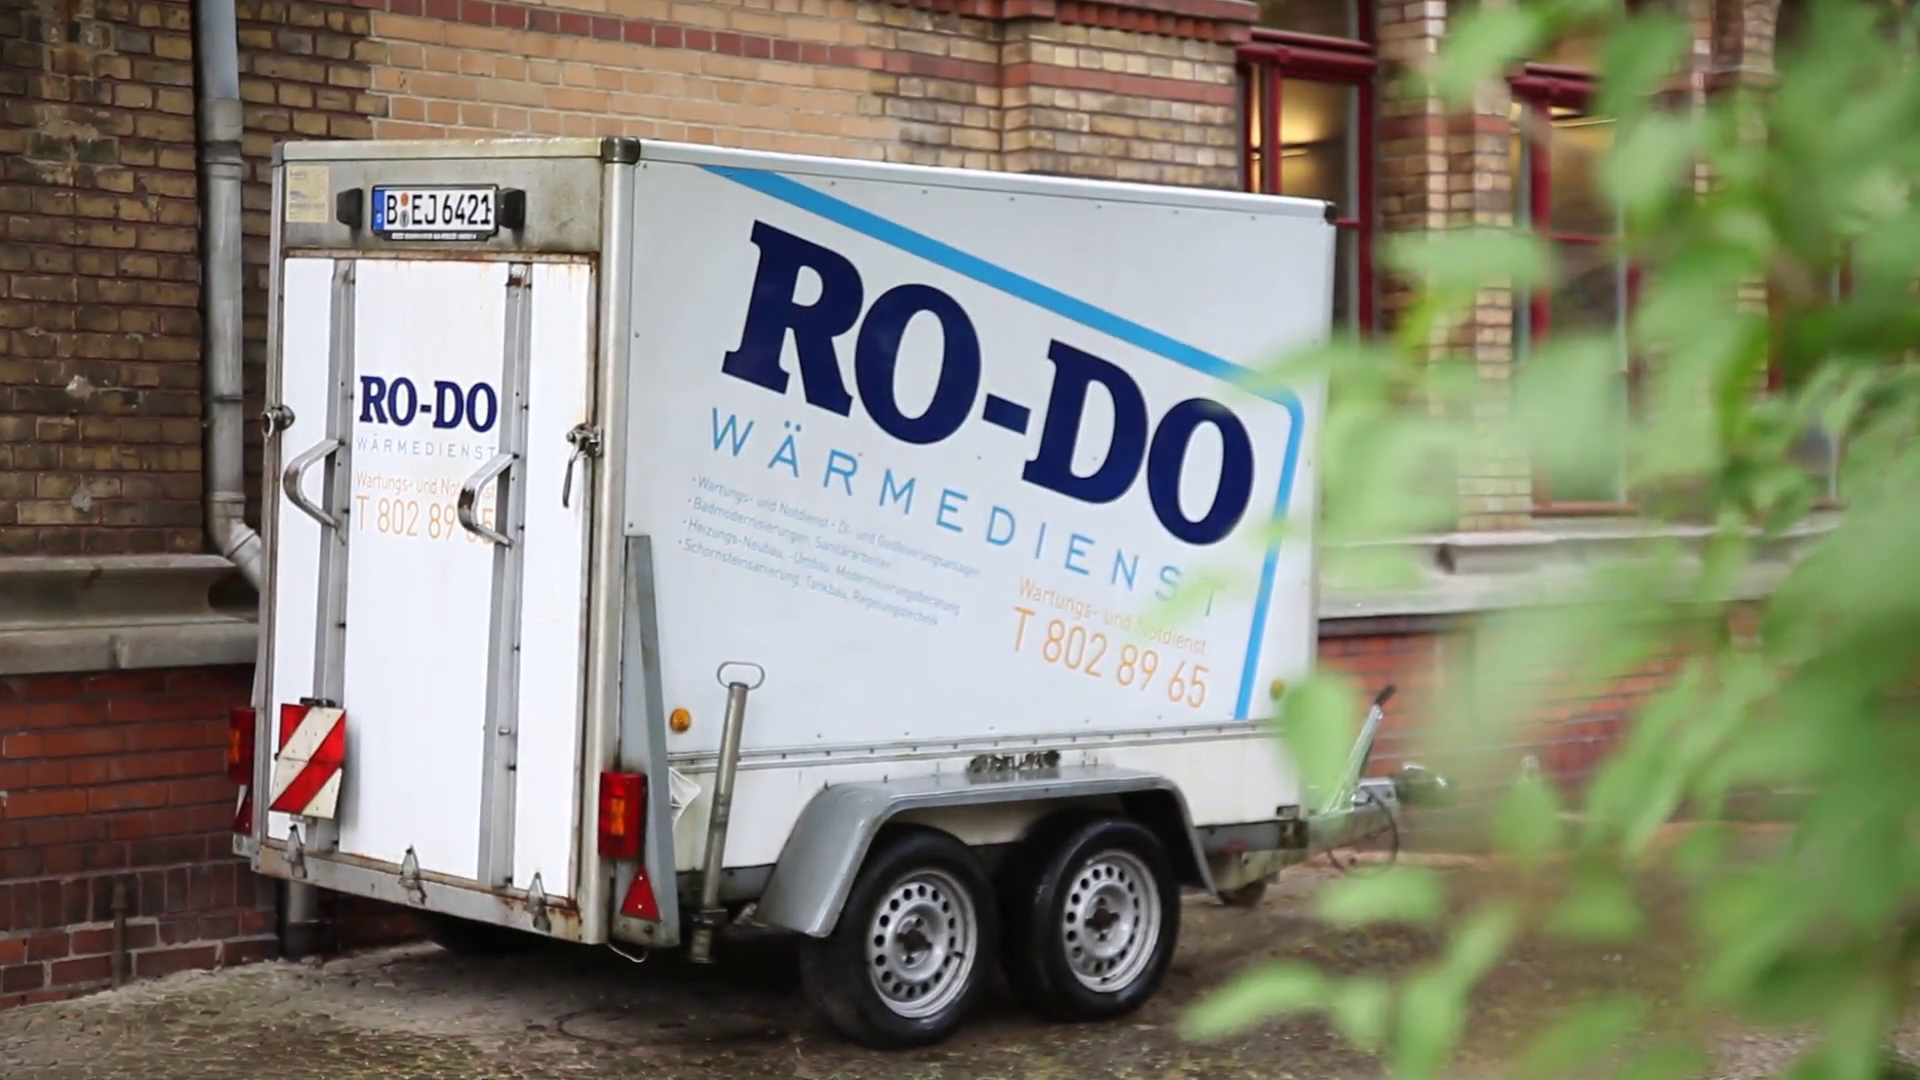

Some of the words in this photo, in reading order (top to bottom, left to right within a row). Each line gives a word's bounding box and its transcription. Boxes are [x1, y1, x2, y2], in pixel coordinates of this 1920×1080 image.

[386, 193, 398, 225] B
[411, 193, 437, 225] EJ
[441, 193, 492, 225] 6421
[359, 375, 498, 433] RO-DO
[721, 219, 1254, 546] RO-DO
[357, 433, 496, 462] WÄRMEDIENST
[356, 471, 413, 496] Wartungs-
[416, 479, 437, 495] und
[756, 499, 777, 512] und
[356, 495, 370, 531] T
[377, 497, 420, 537] 802
[428, 502, 456, 541] 89
[464, 507, 495, 546] 5
[711, 407, 1227, 617] WÄRMEDIENST
[1019, 577, 1098, 620] Wartungs-
[1014, 606, 1036, 652] T
[1043, 619, 1108, 678] 802
[1116, 643, 1159, 692] 89
[1168, 659, 1210, 709] 65
